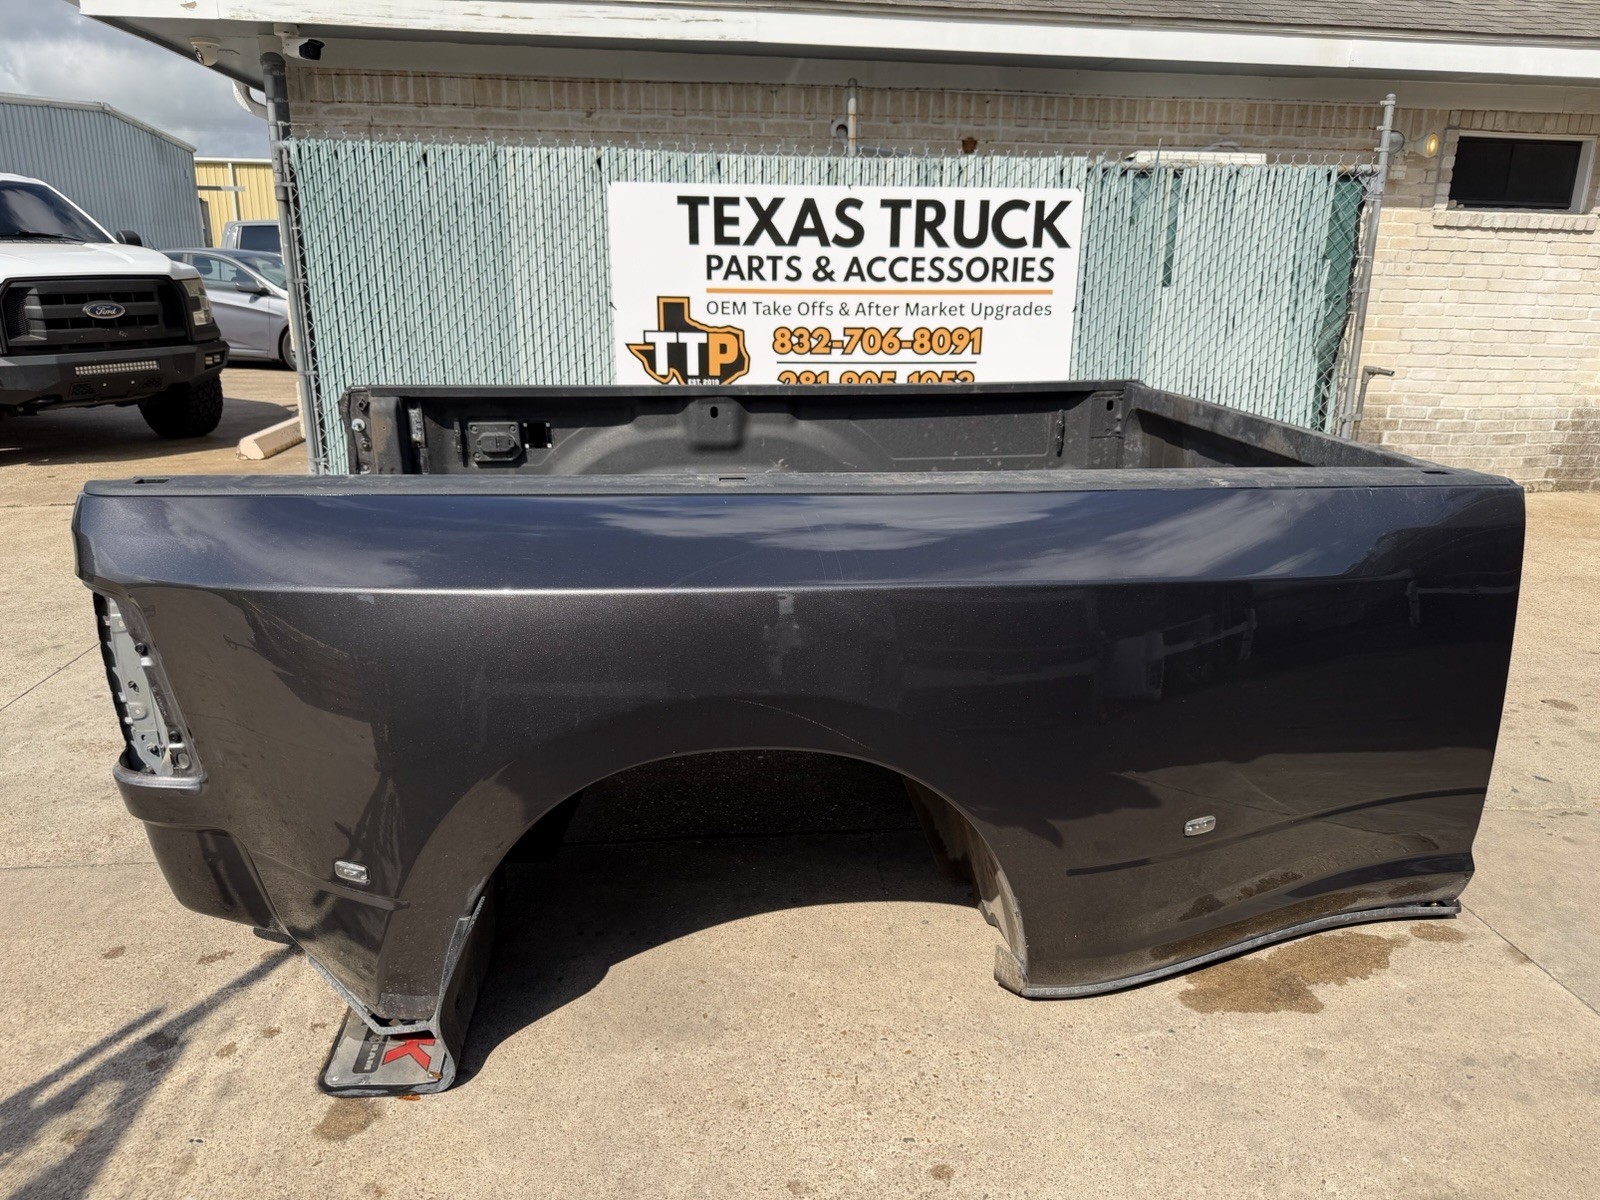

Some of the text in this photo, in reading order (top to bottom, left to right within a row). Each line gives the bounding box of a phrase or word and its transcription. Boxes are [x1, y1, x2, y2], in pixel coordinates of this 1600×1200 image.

[677, 196, 1072, 249] TEXAS TRUCK
[706, 255, 1055, 283] PARTS & ACCESSORIES
[95, 305, 118, 316] Ford
[706, 301, 1052, 320] OEM Take Offs & After Market Upgrades
[644, 331, 739, 376] TTP
[772, 326, 983, 355] 832-706-8091
[363, 1043, 380, 1071] RAM
